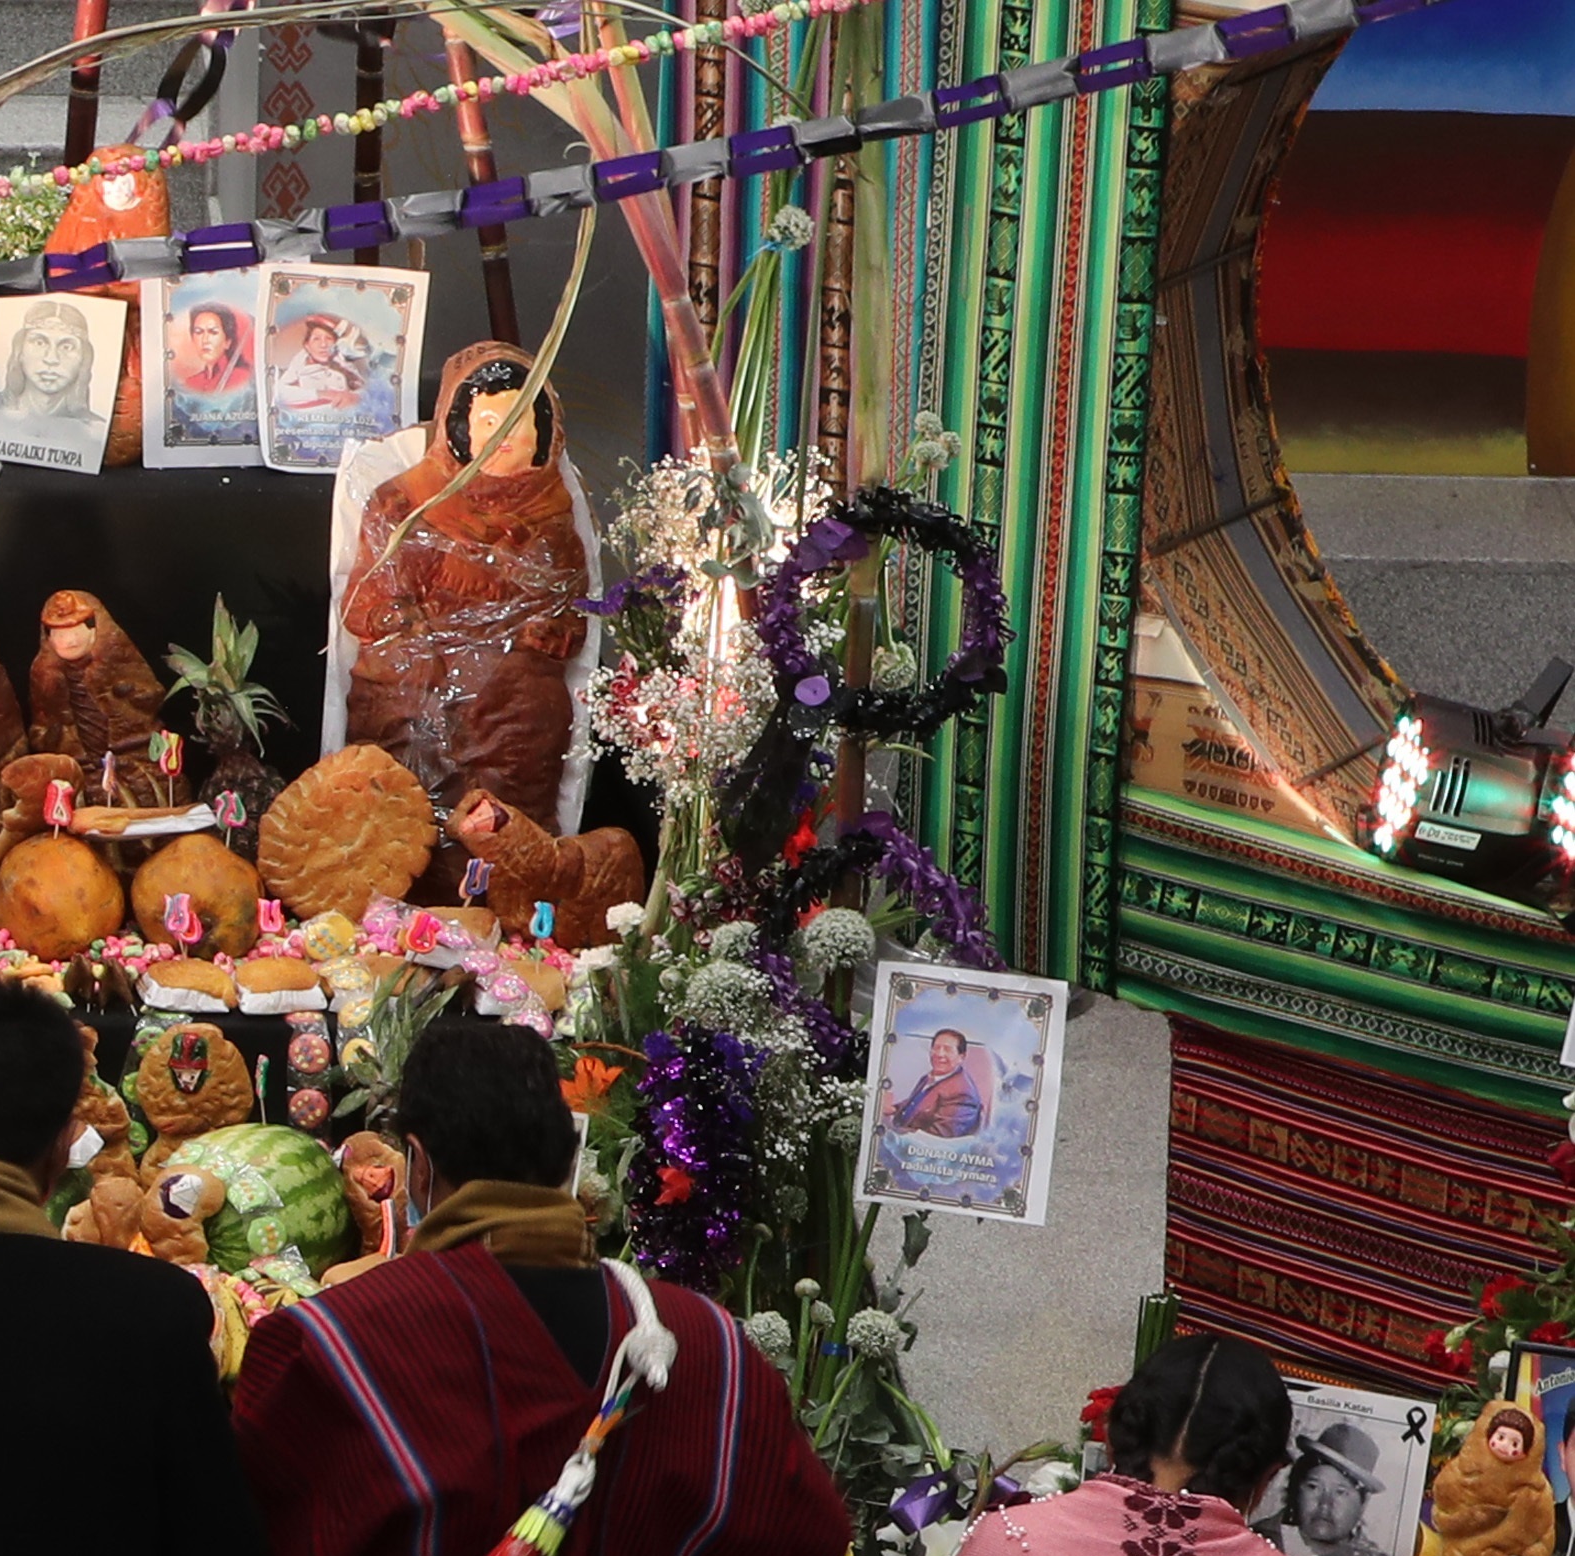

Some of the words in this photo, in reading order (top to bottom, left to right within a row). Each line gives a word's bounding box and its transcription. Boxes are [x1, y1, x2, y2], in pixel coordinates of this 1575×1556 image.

[189, 412, 222, 421] JUANA
[47, 447, 83, 467] TUMPA
[907, 1144, 958, 1162] DONATO
[959, 1153, 995, 1168] AYMA
[901, 1160, 954, 1177] radialista
[956, 1168, 998, 1183] aymara
[1343, 1401, 1374, 1414] Katari
